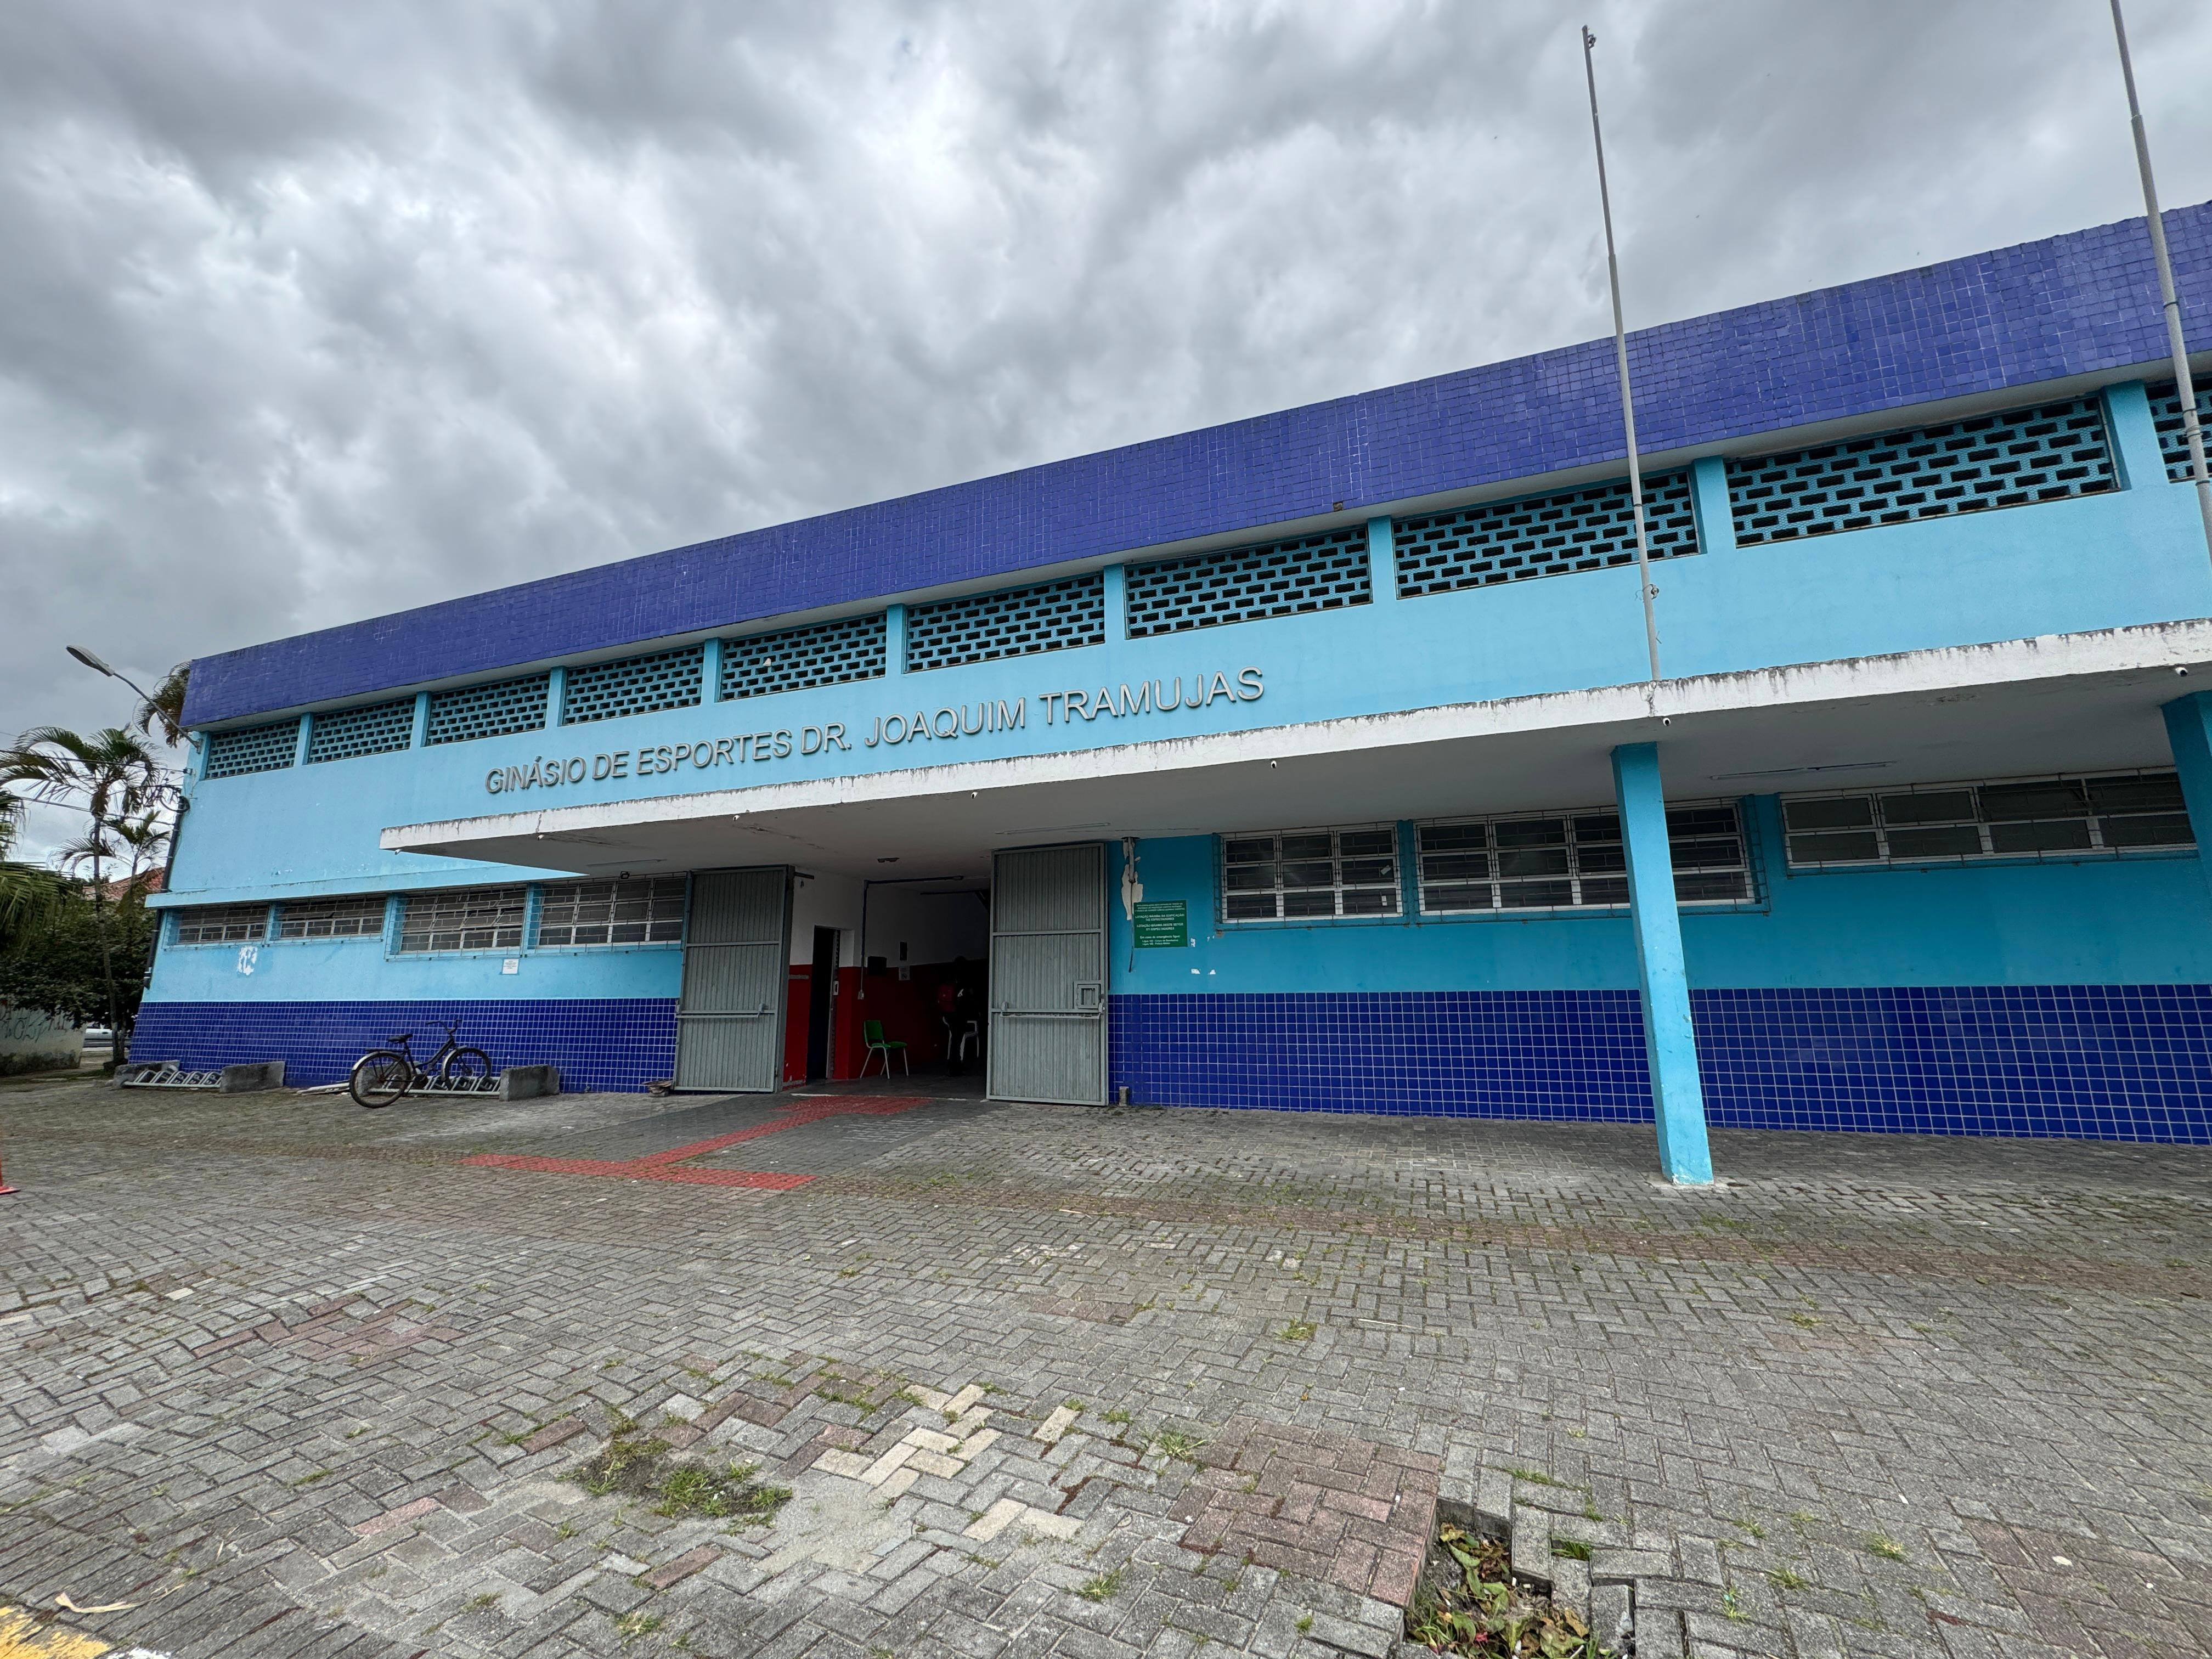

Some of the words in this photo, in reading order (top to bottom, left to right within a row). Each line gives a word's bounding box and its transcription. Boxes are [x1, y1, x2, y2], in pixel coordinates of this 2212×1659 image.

[485, 755, 586, 793] GINÁSIO
[592, 751, 630, 780] DE
[636, 729, 792, 775] ESPORTES
[800, 722, 851, 755] DR.
[864, 697, 1026, 747] JOAQUIM
[1039, 666, 1264, 724] TRAMUJAS
